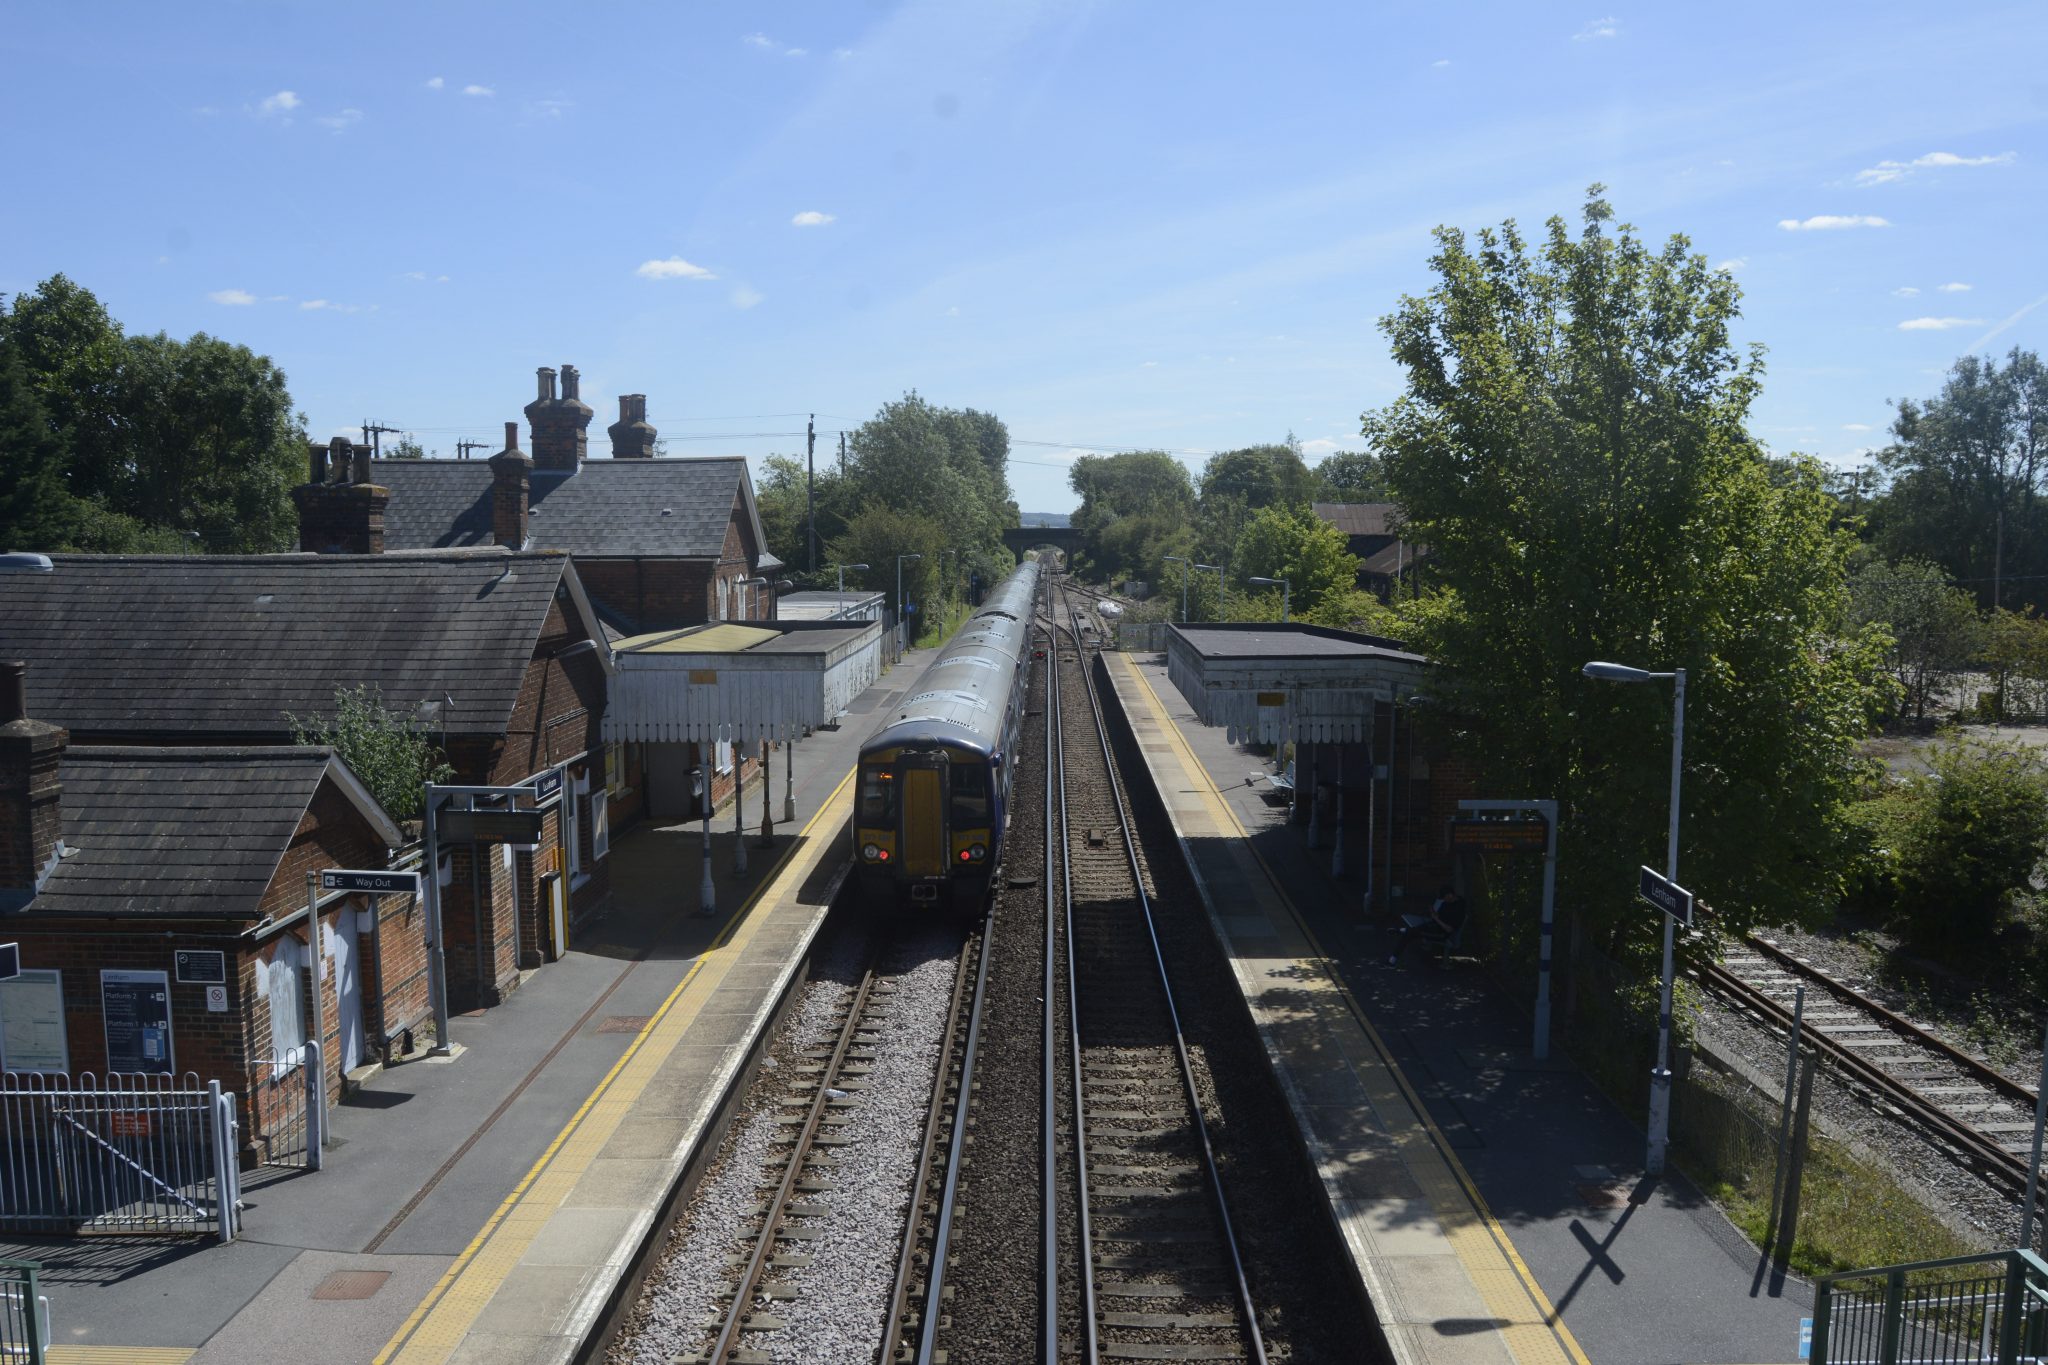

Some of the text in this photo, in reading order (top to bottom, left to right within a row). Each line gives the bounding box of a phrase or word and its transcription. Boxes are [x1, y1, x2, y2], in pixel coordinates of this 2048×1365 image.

[355, 878, 391, 888] Way Out
[1651, 881, 1676, 909] Lenham
[105, 992, 131, 1000] Platform
